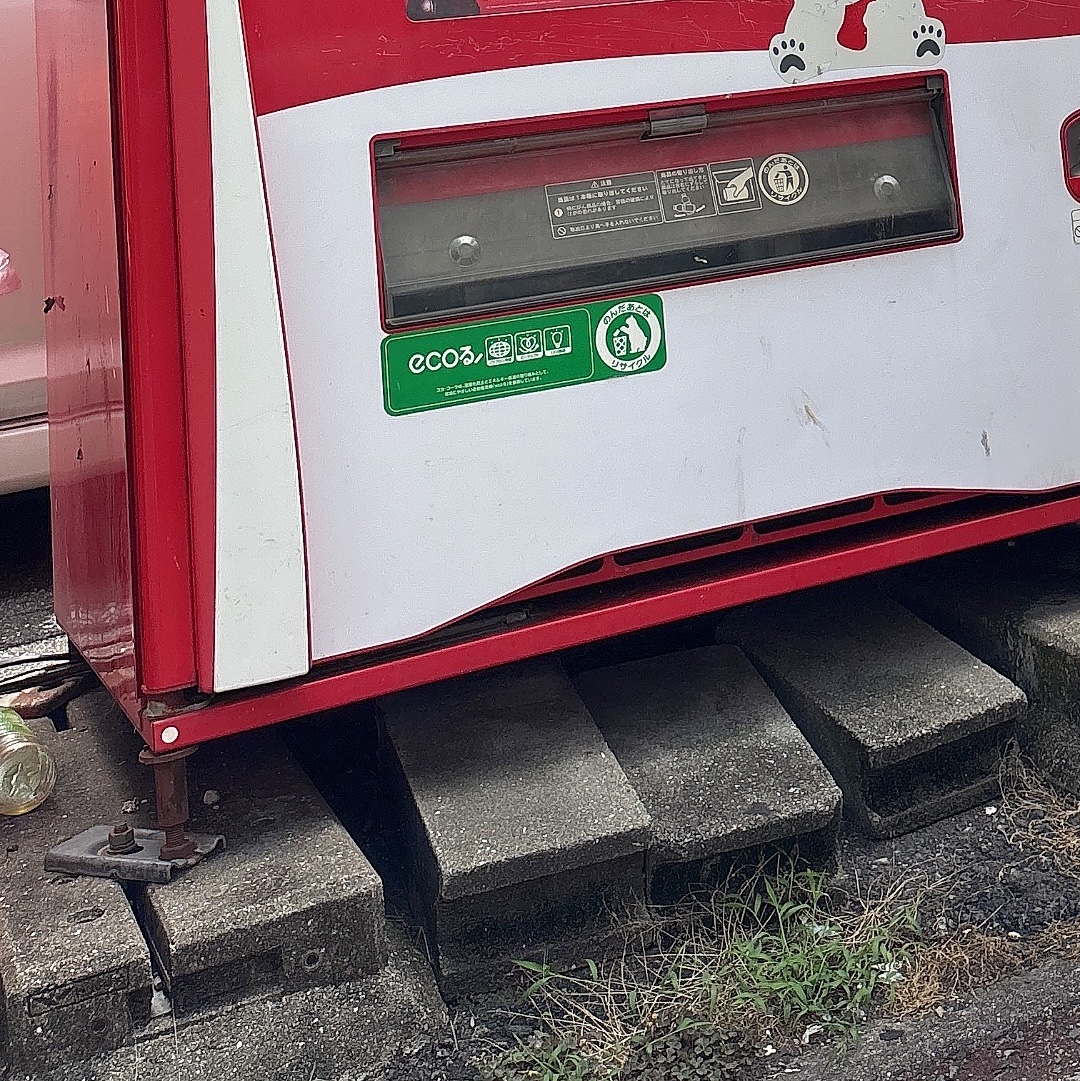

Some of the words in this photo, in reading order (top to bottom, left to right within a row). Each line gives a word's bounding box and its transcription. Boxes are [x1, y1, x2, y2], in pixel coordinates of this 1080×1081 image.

[603, 303, 652, 325] のんだあとは
[611, 353, 651, 370] リサイクル
